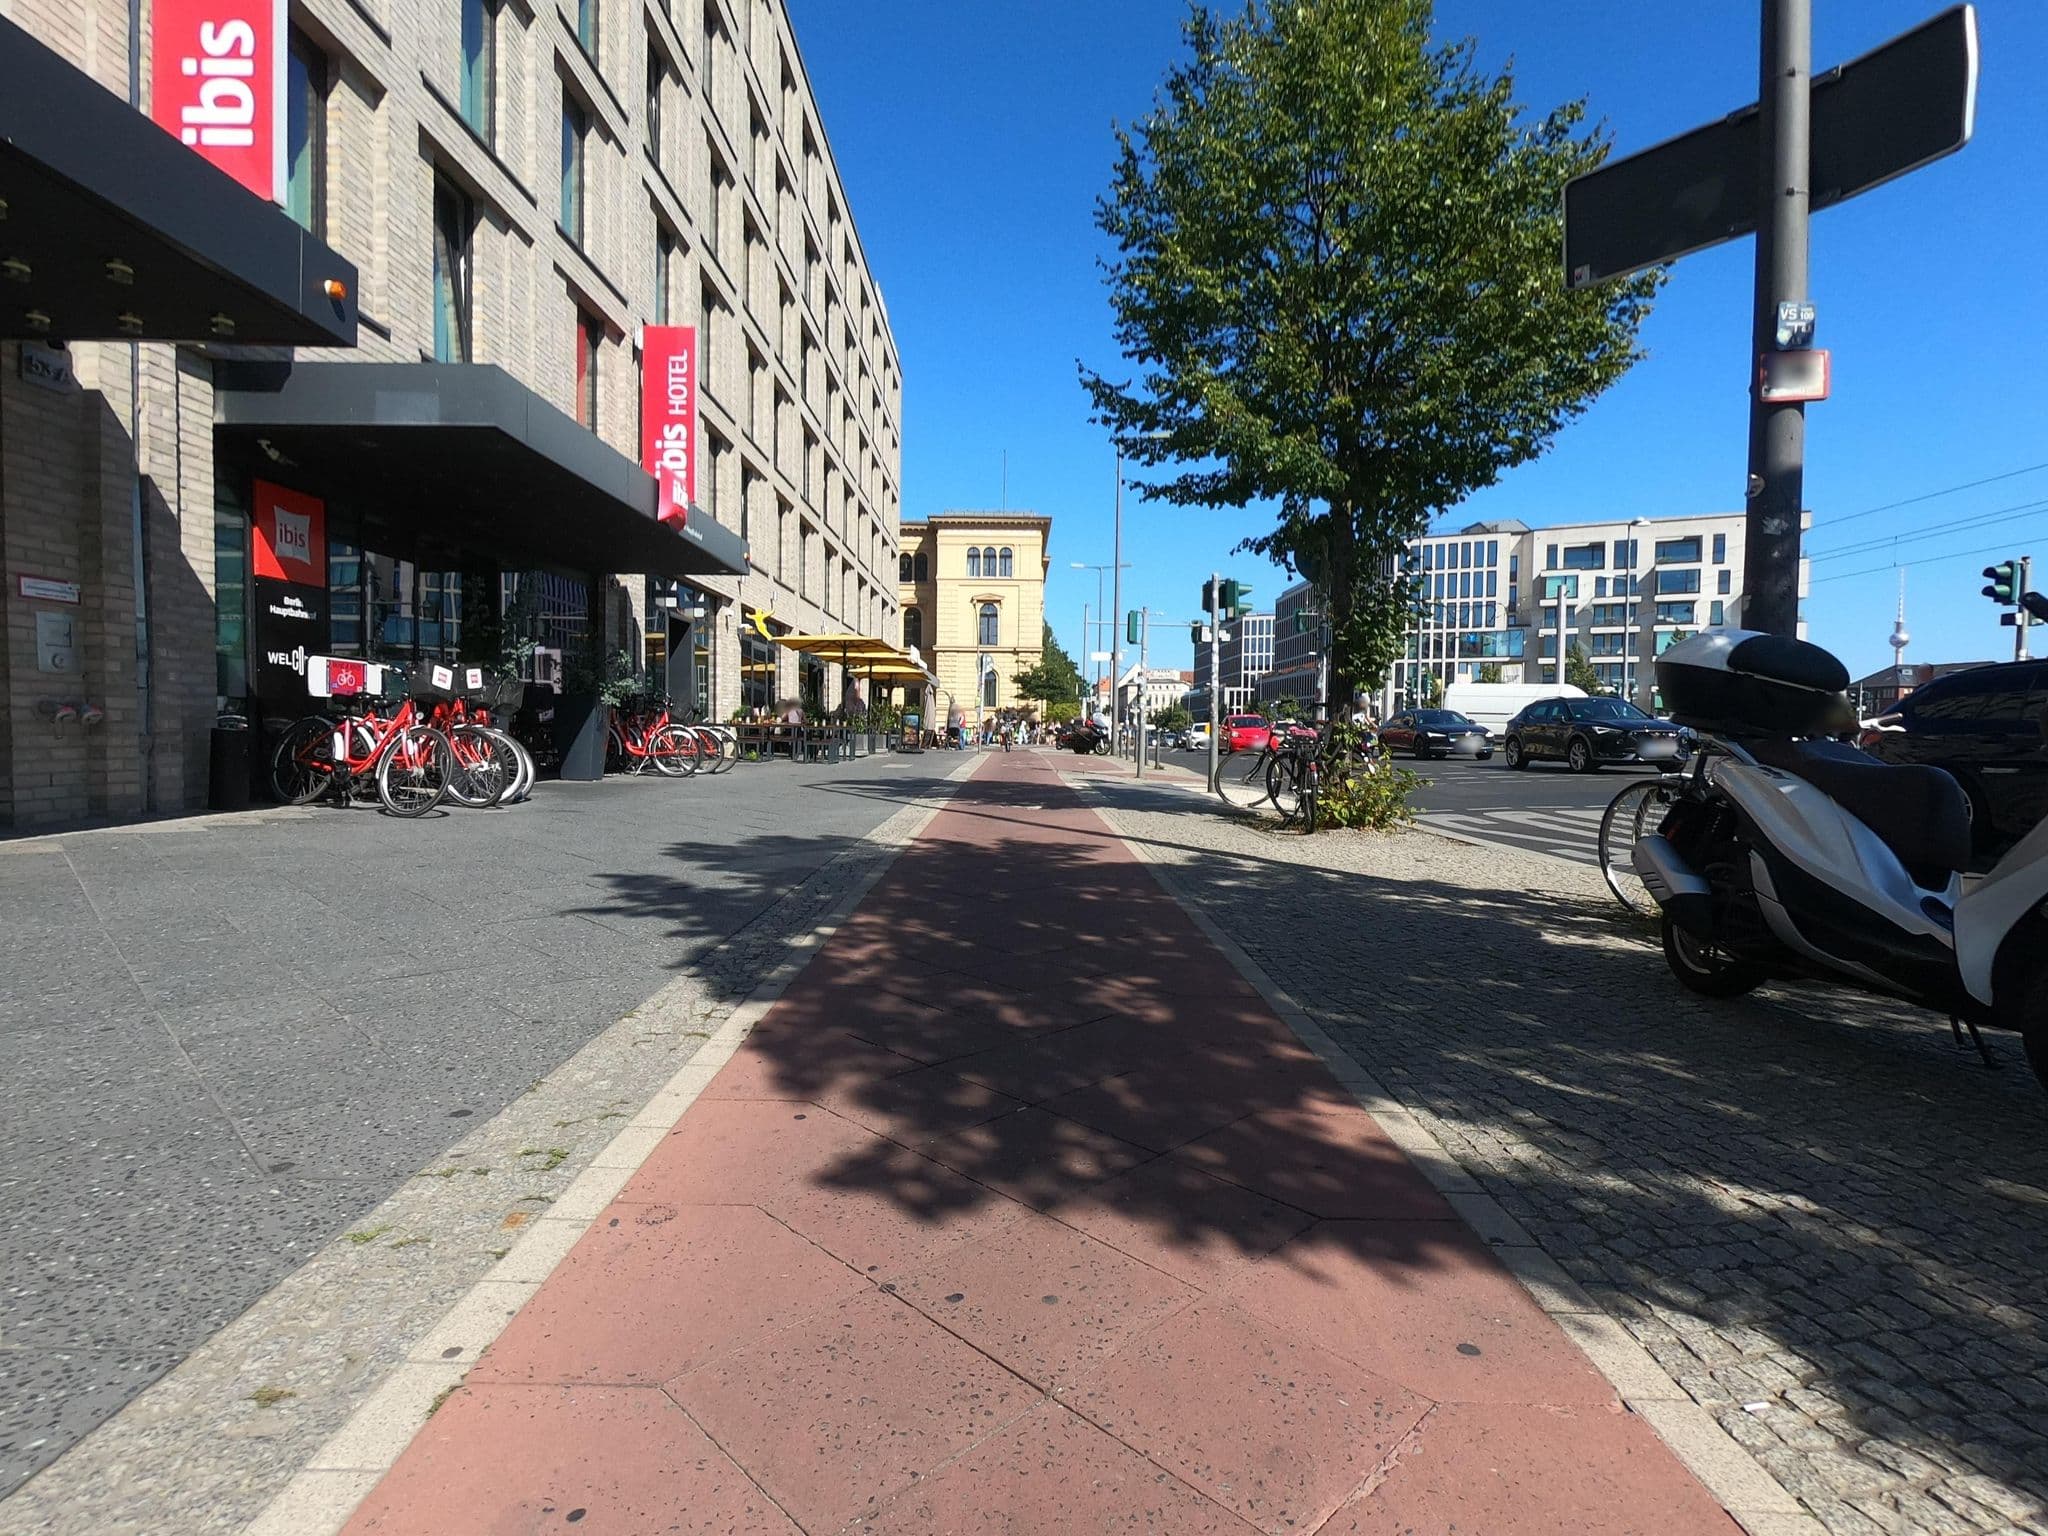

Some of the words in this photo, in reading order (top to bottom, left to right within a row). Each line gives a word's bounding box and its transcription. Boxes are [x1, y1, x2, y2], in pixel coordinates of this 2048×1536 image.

[181, 19, 255, 146] ibis
[1780, 307, 1797, 320] VS
[668, 349, 688, 415] HOTEL
[279, 523, 306, 547] ibis
